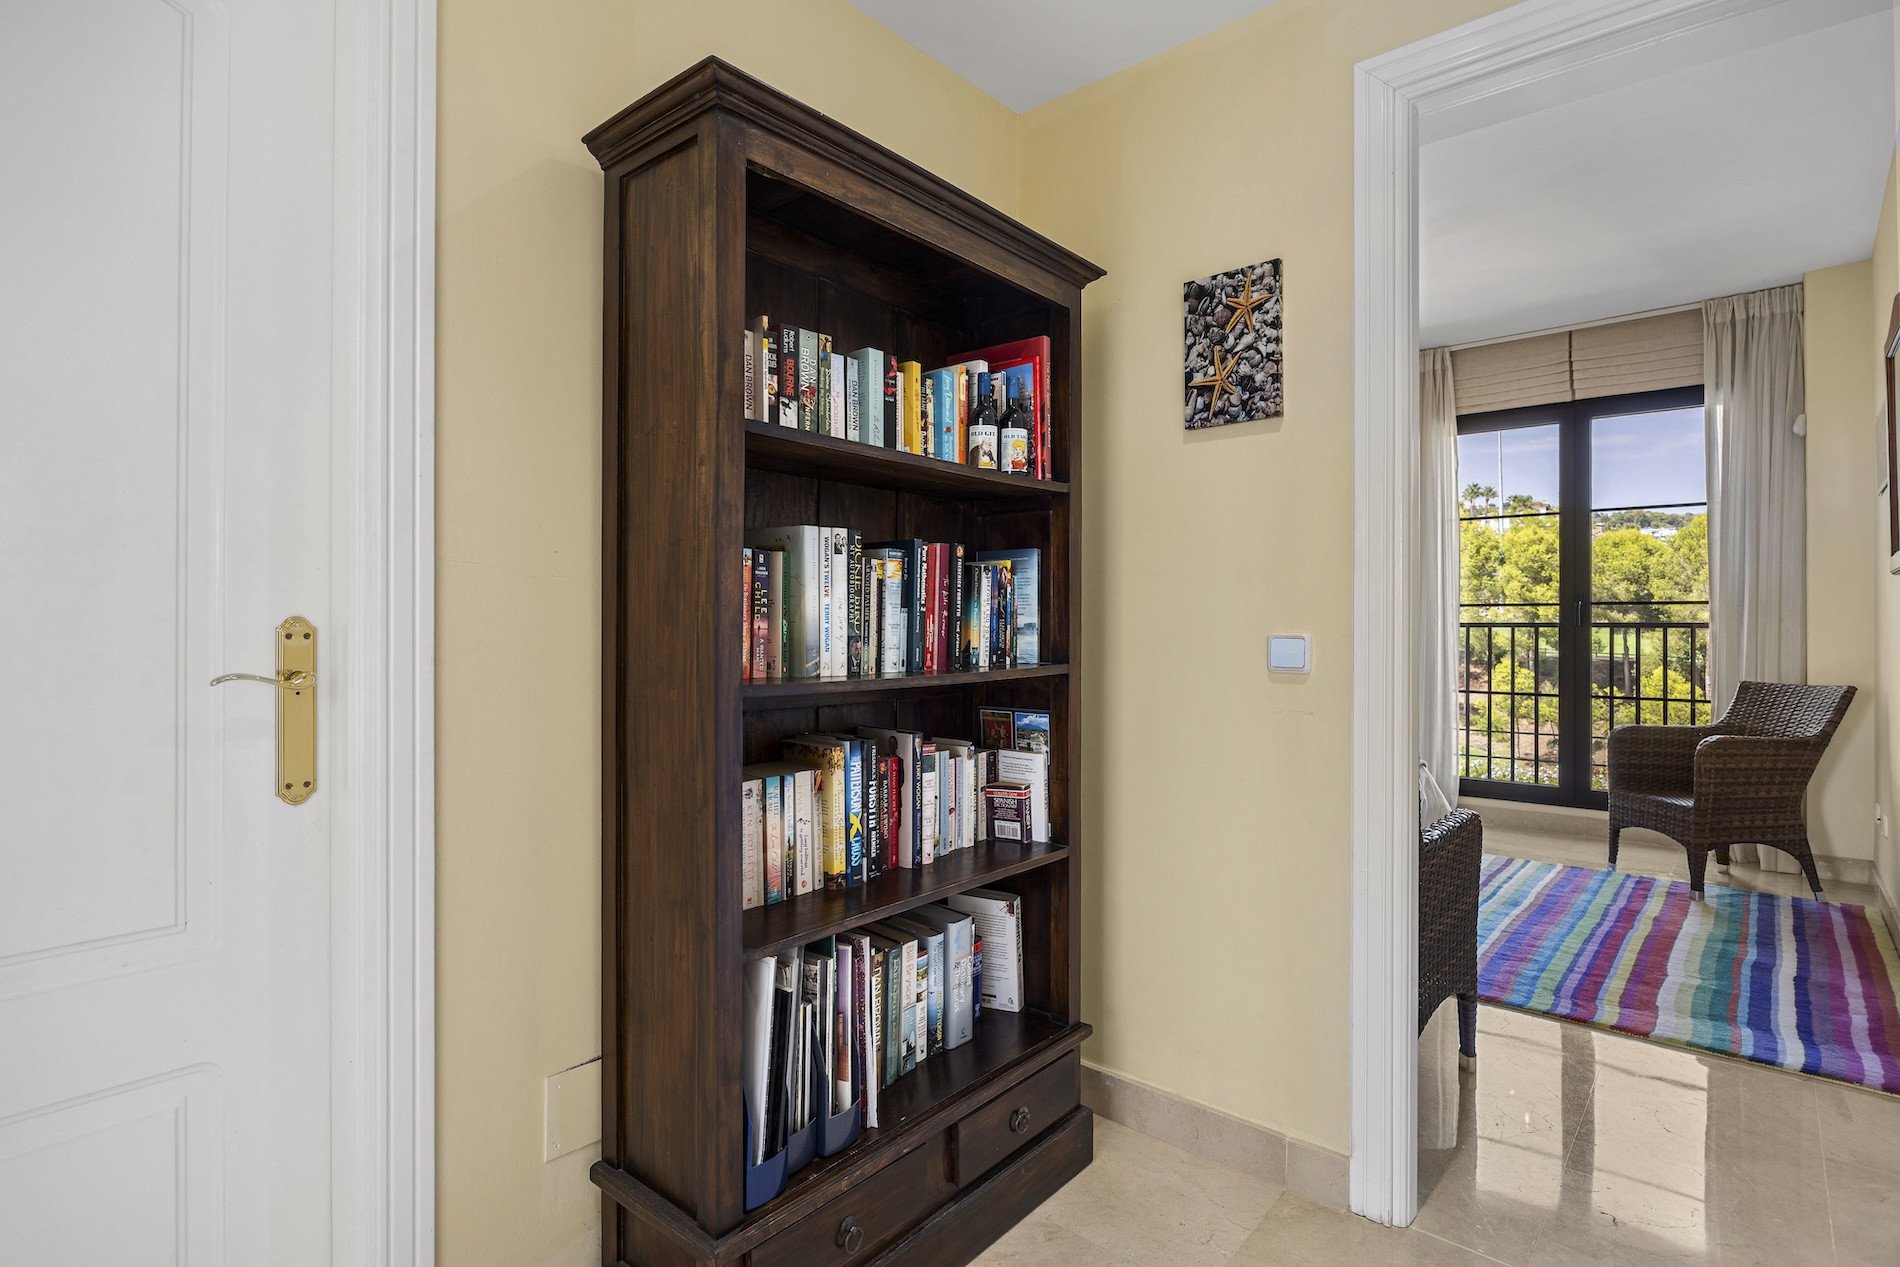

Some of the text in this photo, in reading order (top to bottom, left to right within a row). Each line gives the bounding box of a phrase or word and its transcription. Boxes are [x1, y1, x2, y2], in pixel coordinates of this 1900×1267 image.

[788, 330, 796, 352] Robert
[786, 358, 795, 398] BOURNE
[801, 347, 810, 391] BROWN
[809, 359, 817, 384] DAN
[824, 392, 832, 432] Chamberlain
[849, 544, 855, 556] MY
[754, 582, 762, 620] CHILD
[838, 592, 847, 610] The
[854, 534, 862, 634] DICKIE BIRD
[920, 562, 928, 604] Mathematics
[941, 590, 949, 606] Kite
[941, 609, 949, 639] Runner
[772, 785, 780, 817] RACHEL
[836, 786, 844, 816] Thousand
[850, 761, 863, 813] PATTERSON
[868, 780, 877, 829] FORSYTH
[993, 797, 1017, 805] SPANISH
[746, 804, 755, 882] KEN FOLLETT
[836, 817, 844, 847] Splendid
[850, 836, 863, 867] CROSS
[904, 944, 915, 1006] Bill Bryson
[958, 958, 968, 1013] Dictionary
[965, 954, 974, 986] Collins
[953, 968, 961, 1023] Thesaurus
[874, 995, 882, 1047] BROWN
